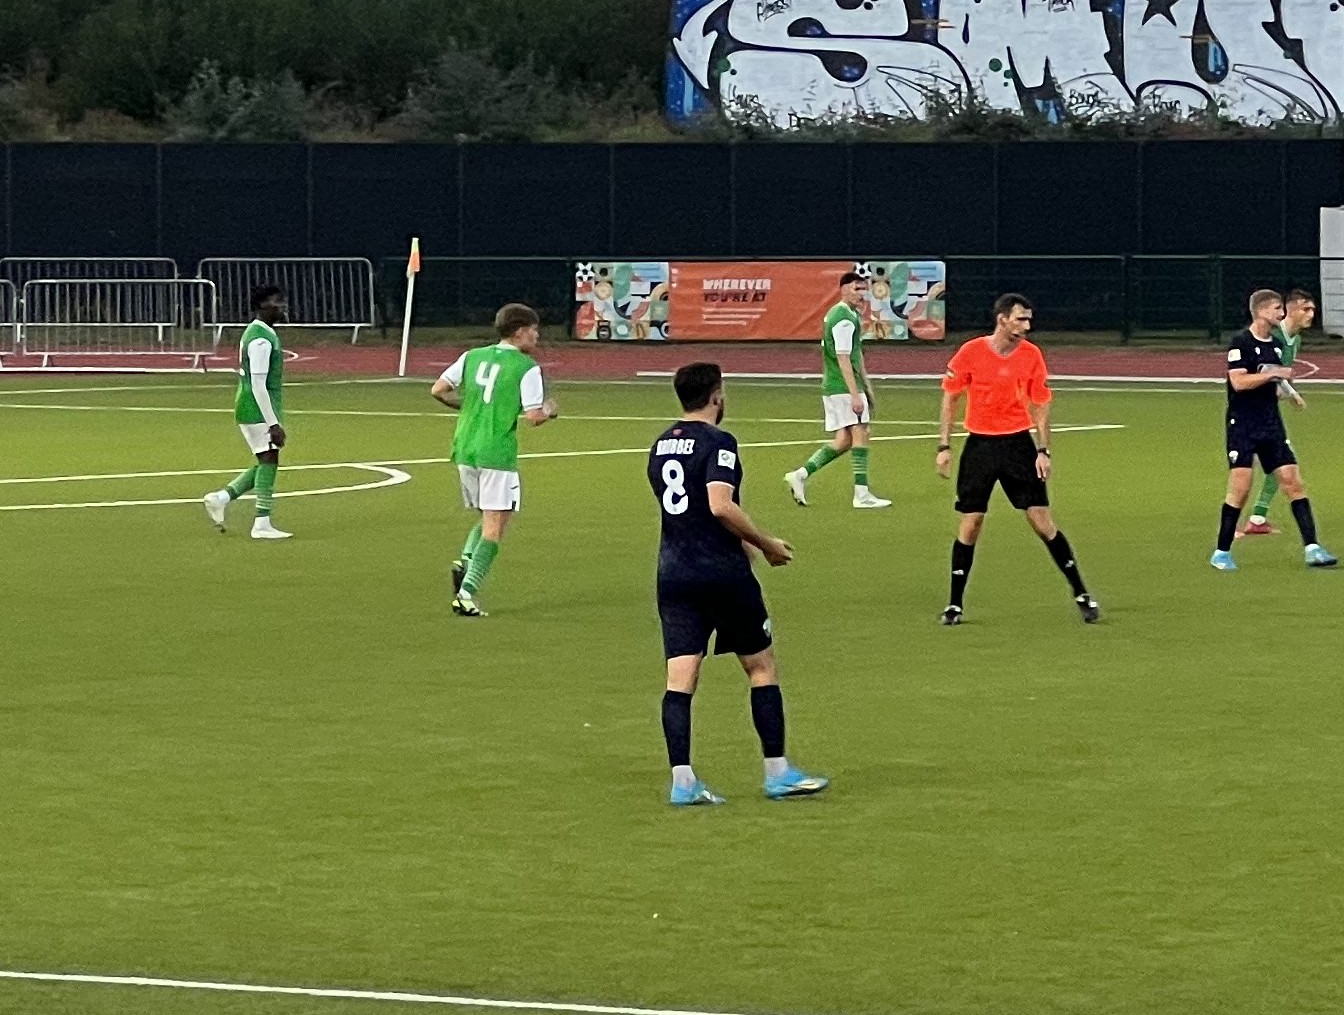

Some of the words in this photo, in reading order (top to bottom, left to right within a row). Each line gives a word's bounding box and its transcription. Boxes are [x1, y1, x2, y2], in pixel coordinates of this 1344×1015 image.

[702, 279, 771, 290] WHEREVER
[475, 360, 501, 404] 4
[661, 459, 689, 515] 8
